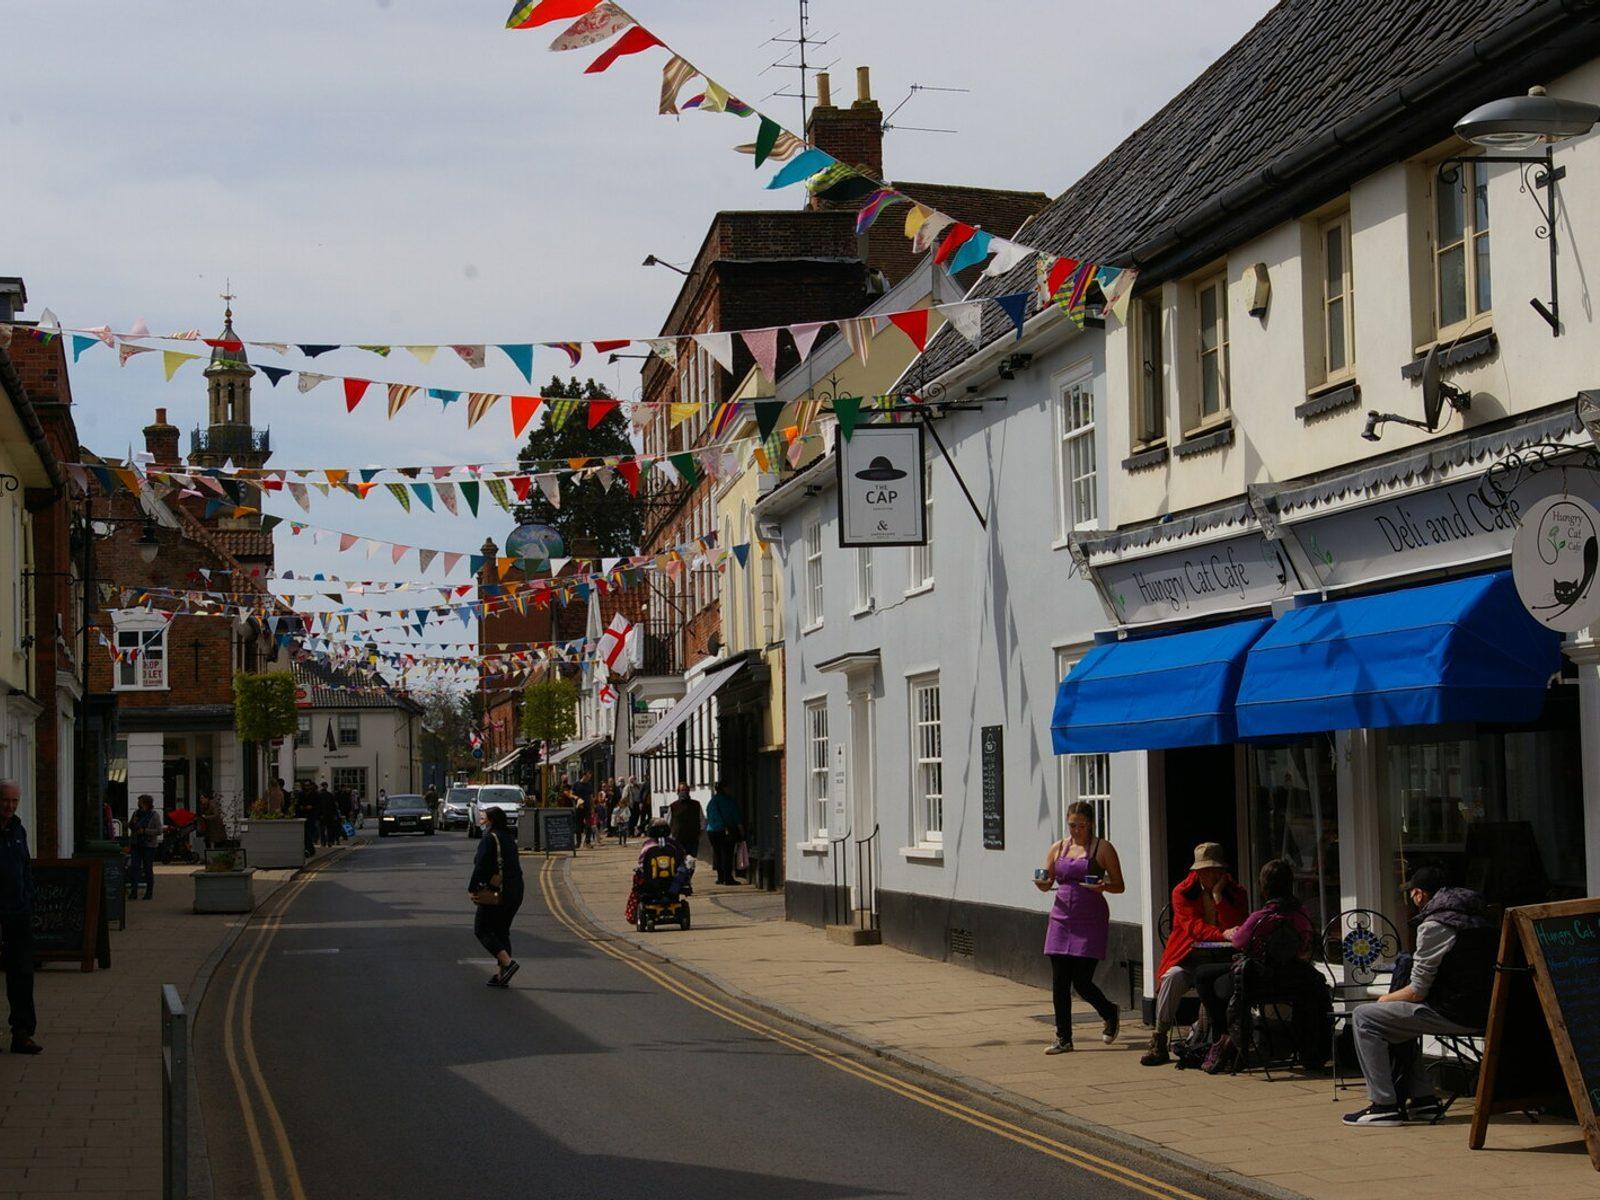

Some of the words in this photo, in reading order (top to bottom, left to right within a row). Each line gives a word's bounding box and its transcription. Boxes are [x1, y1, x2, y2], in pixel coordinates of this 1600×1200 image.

[866, 490, 898, 504] CAP
[1374, 505, 1428, 552] Deli
[1426, 492, 1474, 542] and
[1552, 510, 1582, 526] Hungry
[1567, 527, 1582, 538] Cat
[1132, 571, 1189, 612] Hungry
[1184, 561, 1216, 594] Cat
[1210, 547, 1250, 600] Cafe
